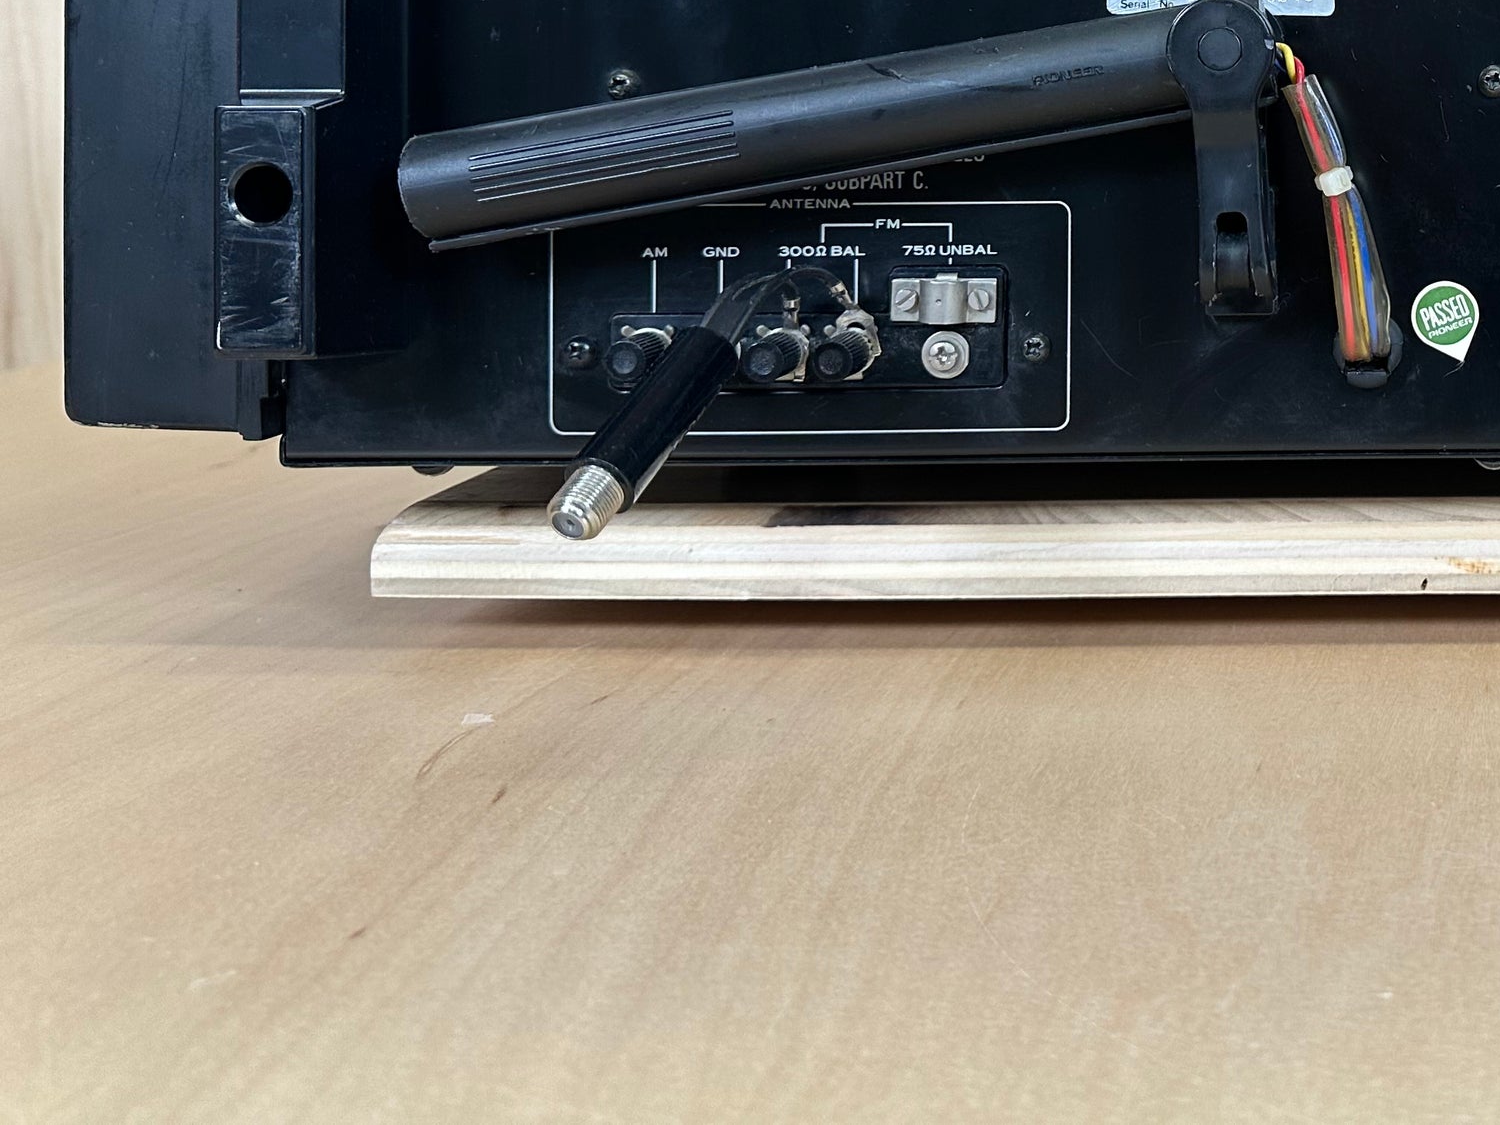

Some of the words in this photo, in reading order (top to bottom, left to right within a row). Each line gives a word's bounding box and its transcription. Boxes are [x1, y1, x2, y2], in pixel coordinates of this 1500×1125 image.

[1120, 0, 1150, 8] Serial
[913, 171, 928, 189] C.
[770, 199, 853, 208] ANTENNA
[876, 219, 900, 229] FM
[642, 247, 667, 257] AM
[703, 247, 739, 257] GND
[831, 246, 865, 256] BAL
[939, 245, 997, 255] UNBAL
[1420, 294, 1470, 331] PASSED
[1429, 317, 1472, 339] PIONEER
